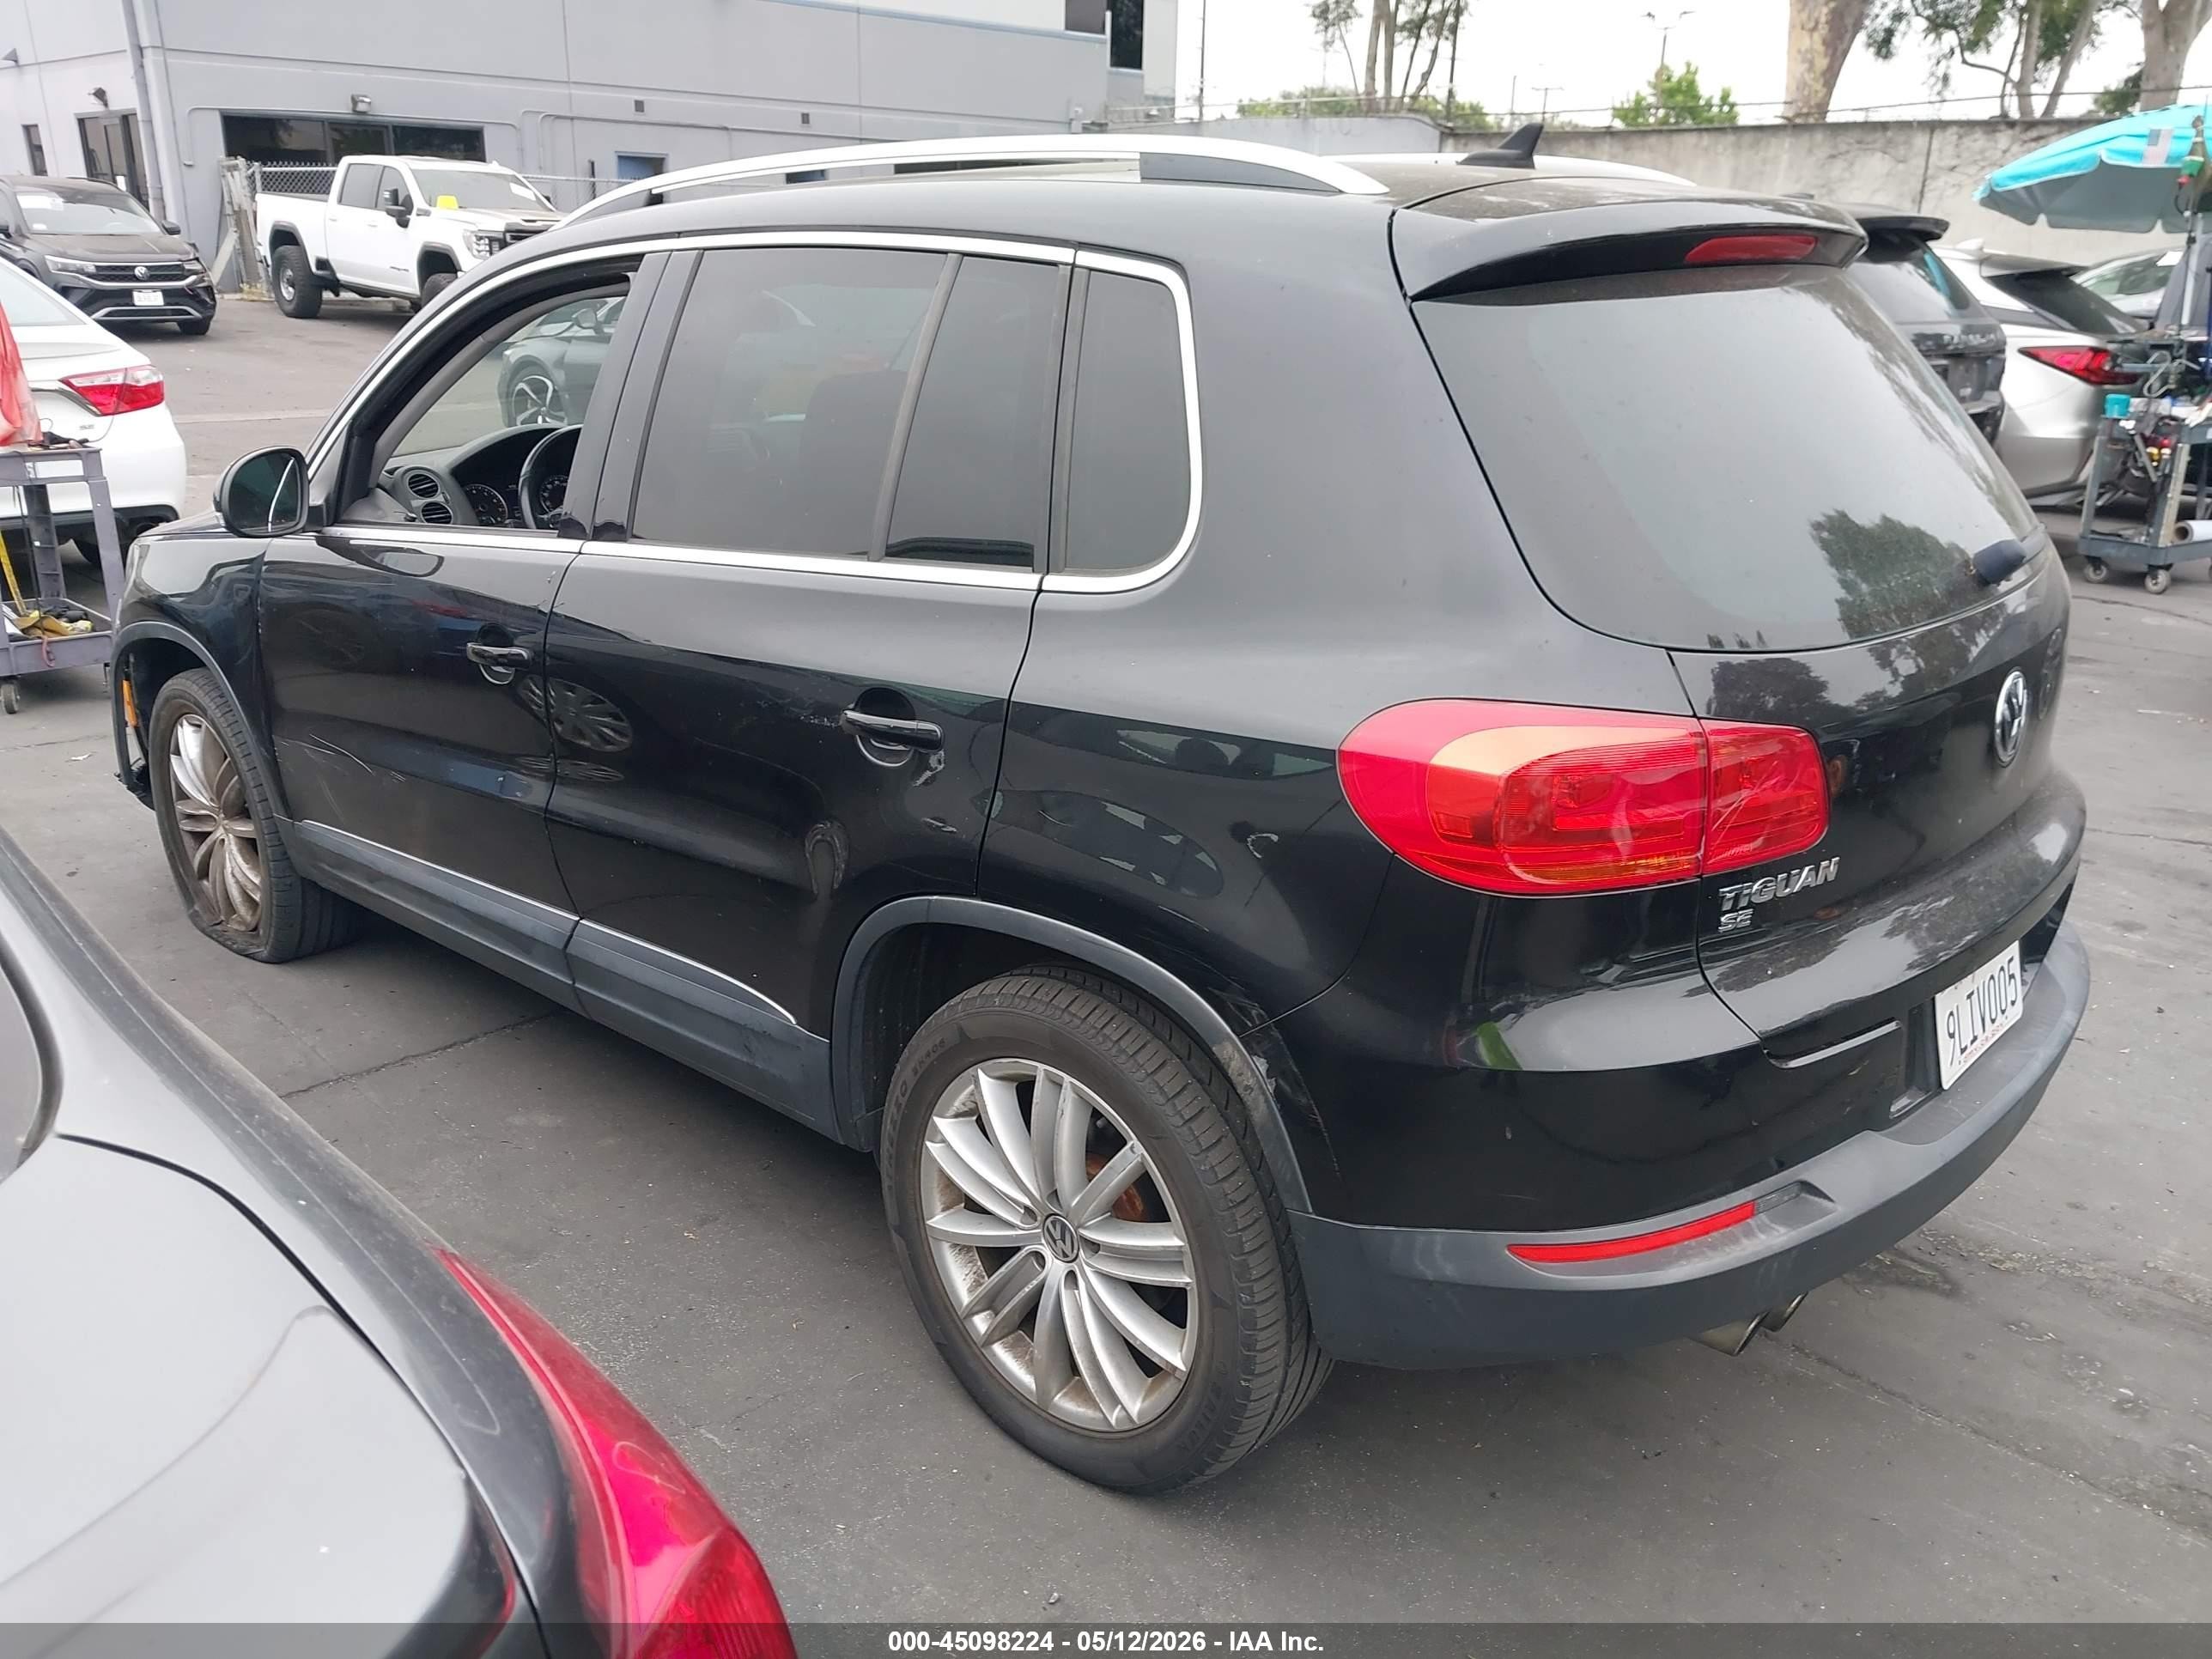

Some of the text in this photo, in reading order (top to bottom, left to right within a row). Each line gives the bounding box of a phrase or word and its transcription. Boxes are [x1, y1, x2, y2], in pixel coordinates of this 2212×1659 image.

[1718, 856, 1840, 911] TIGUAN
[1718, 908, 1754, 933] SE
[1945, 955, 2020, 1067] 9LIV005
